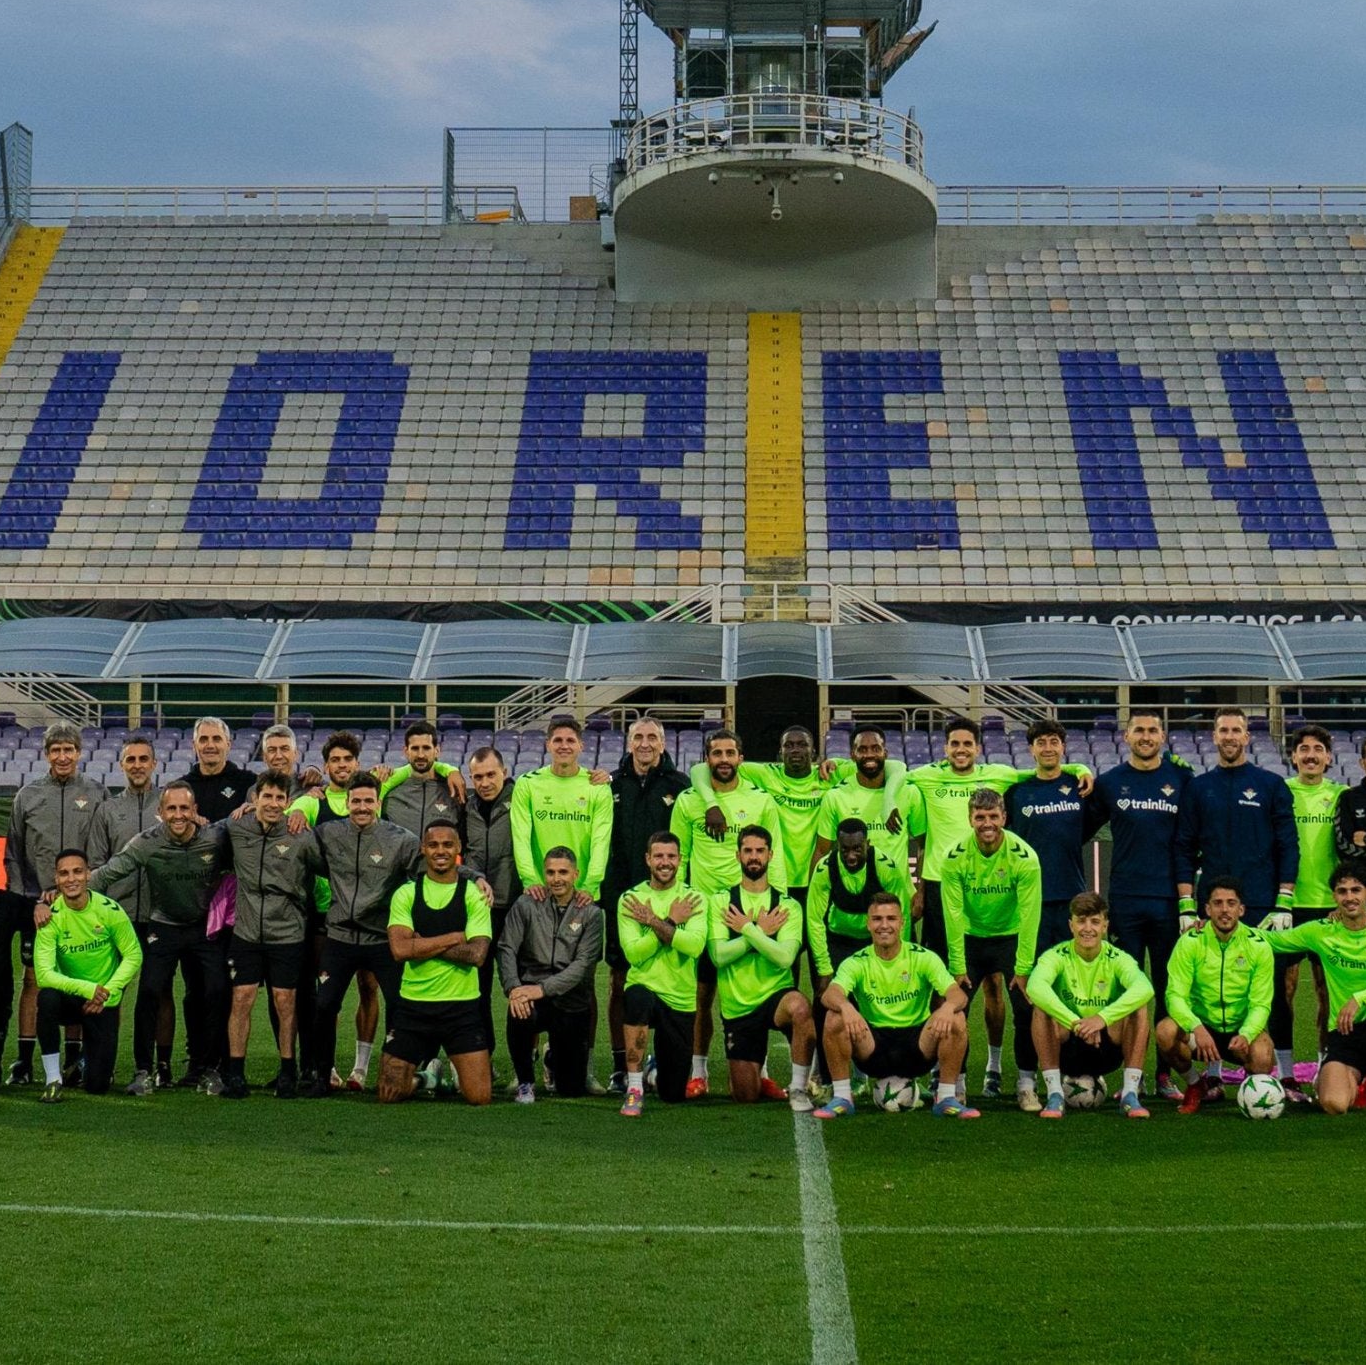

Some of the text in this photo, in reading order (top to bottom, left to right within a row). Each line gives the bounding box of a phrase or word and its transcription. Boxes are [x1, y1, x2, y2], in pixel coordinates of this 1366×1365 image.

[1034, 800, 1081, 815] trainline
[1131, 799, 1179, 814] trainline
[549, 809, 592, 823] trainline
[1295, 813, 1335, 824] rainlin
[69, 938, 110, 954] trainlin
